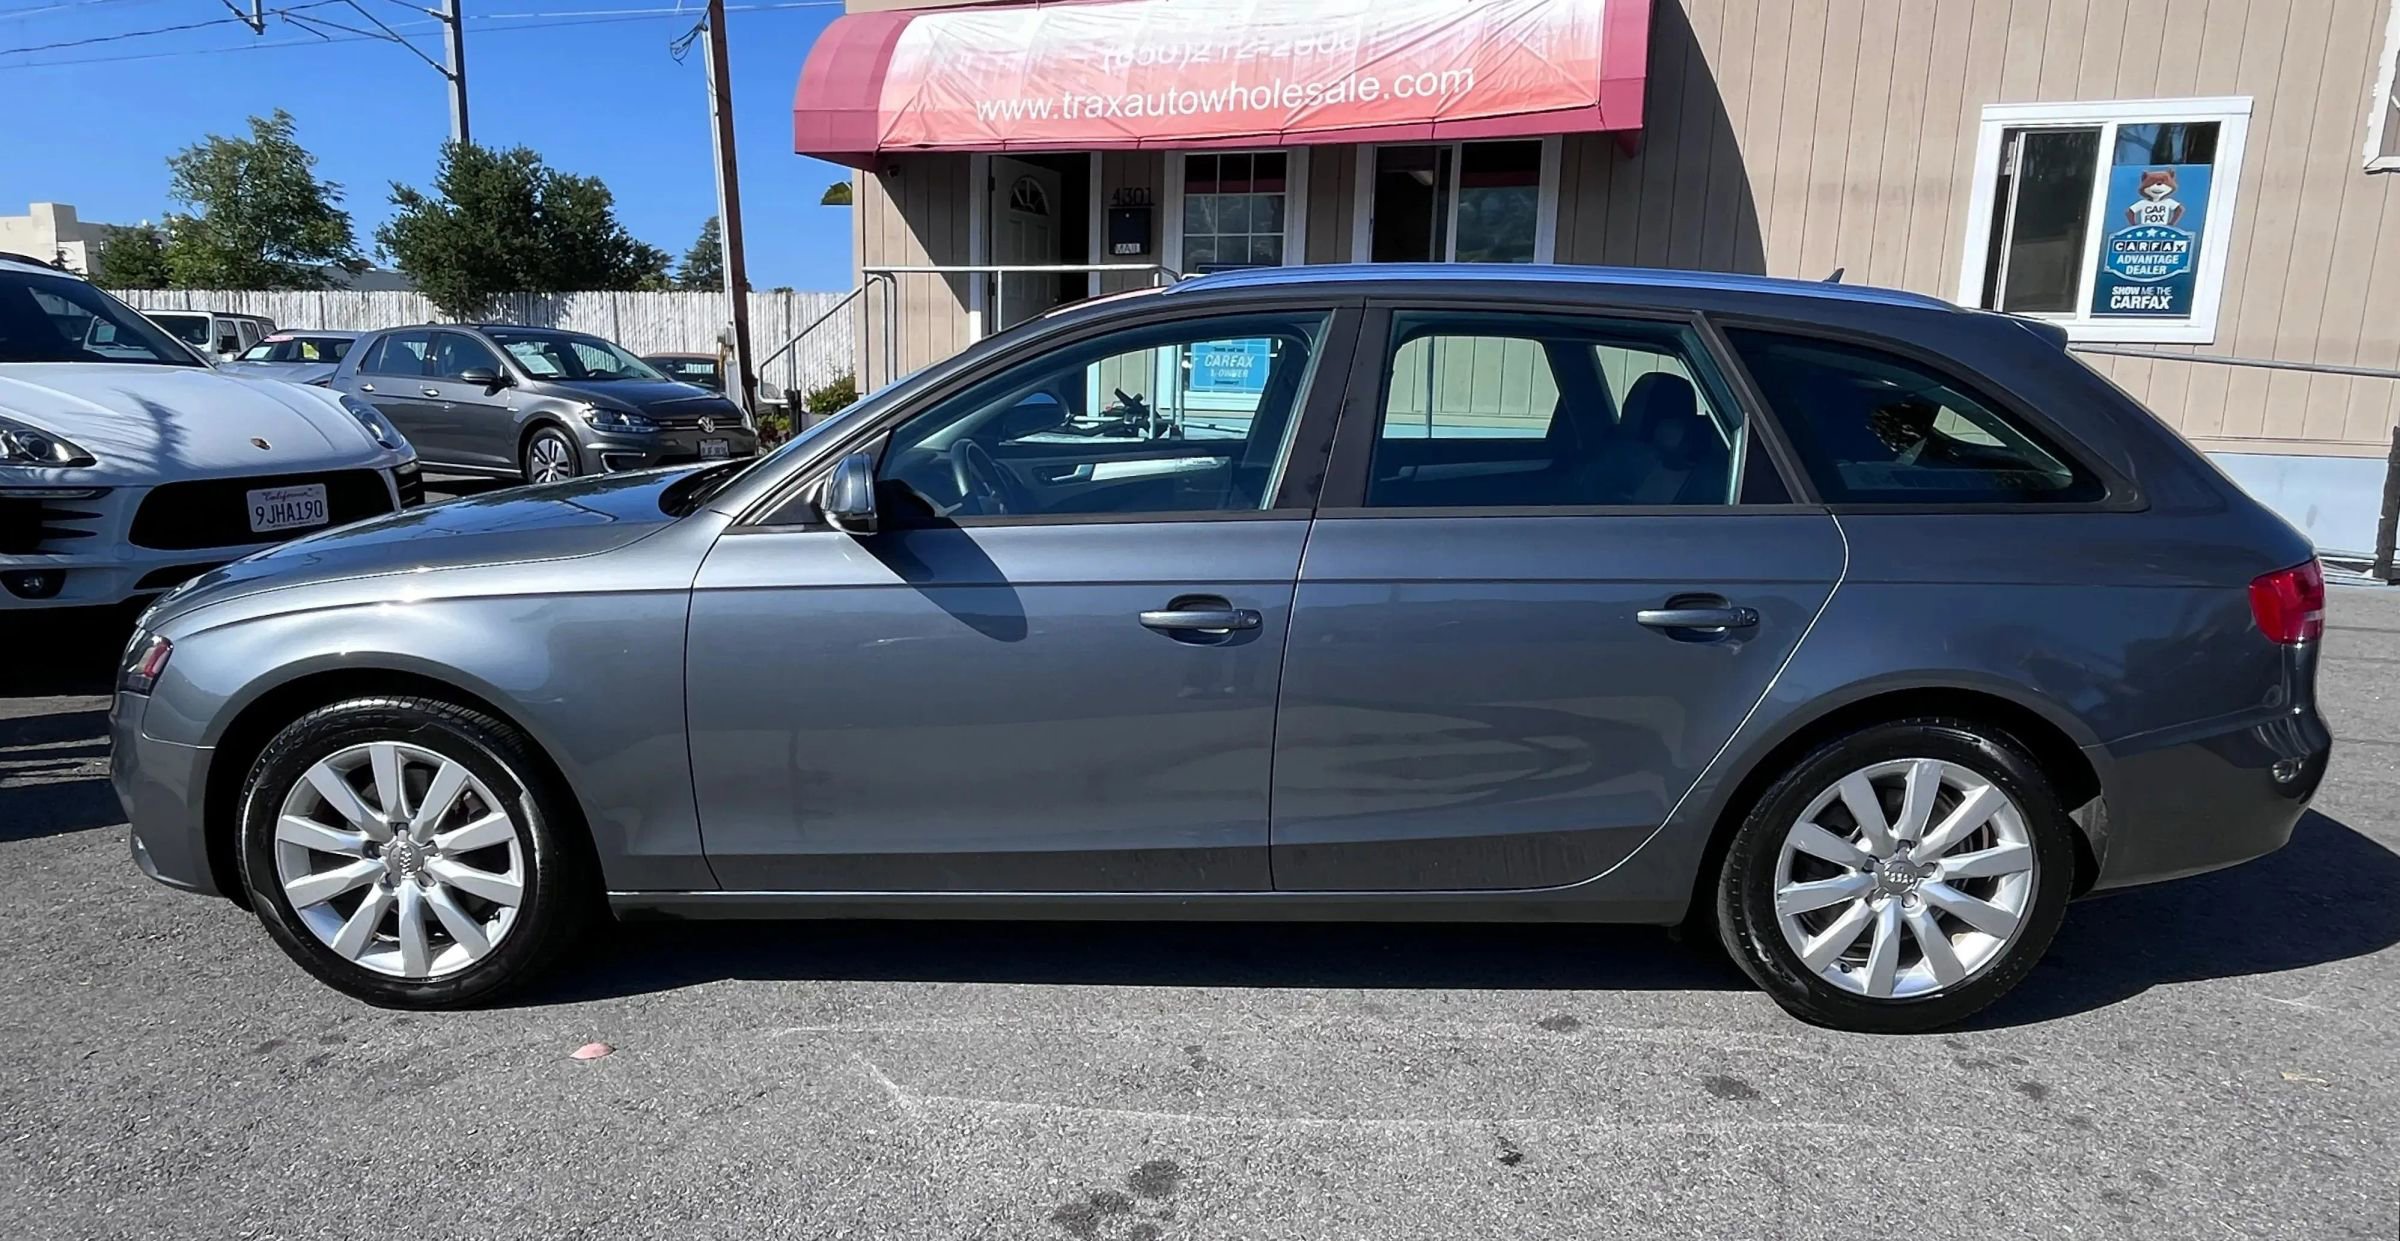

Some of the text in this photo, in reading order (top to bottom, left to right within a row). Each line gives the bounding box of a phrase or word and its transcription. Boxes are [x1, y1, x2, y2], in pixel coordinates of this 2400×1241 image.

[975, 66, 1477, 121] www.traxautowholesale.com
[1111, 187, 1154, 206] 4301
[2144, 205, 2166, 214] CAR
[2144, 214, 2165, 223] FOX
[2113, 241, 2187, 252] CARFAX
[2116, 254, 2180, 265] ADVANTAGE
[2125, 265, 2168, 275] DEALER
[2111, 286, 2173, 295] SHOW ME THE
[2110, 295, 2174, 310] CARFAX
[1204, 353, 1256, 369] CARFAX
[255, 499, 323, 526] 9JHA190
